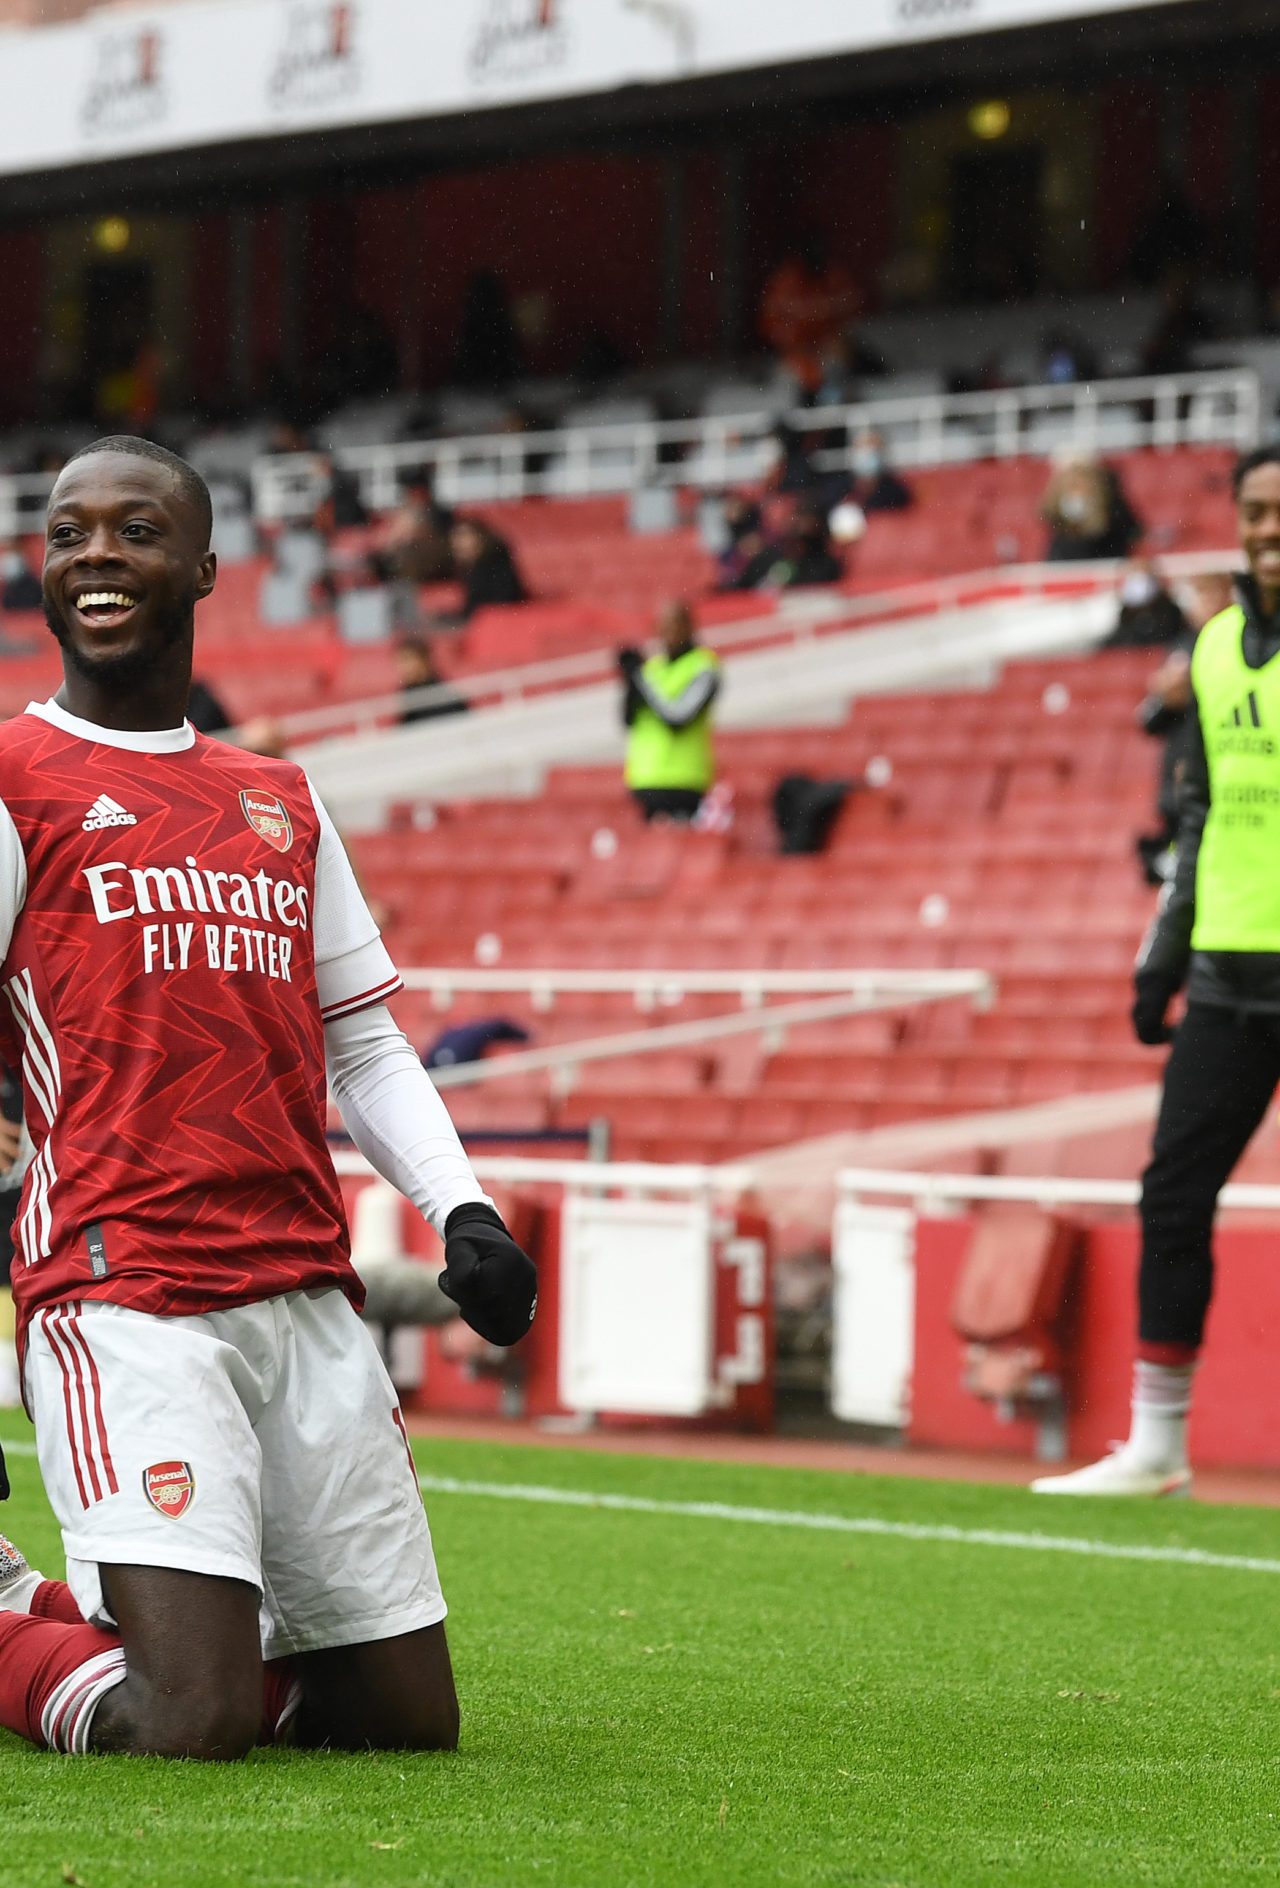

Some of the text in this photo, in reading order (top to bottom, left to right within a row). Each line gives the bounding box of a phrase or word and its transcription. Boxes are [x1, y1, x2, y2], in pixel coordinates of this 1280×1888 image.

[247, 799, 282, 815] Arsenal
[81, 813, 138, 832] adidas
[81, 855, 308, 931] Emirates
[143, 922, 292, 983] FLY BETTER
[149, 1468, 187, 1484] Arsenal
